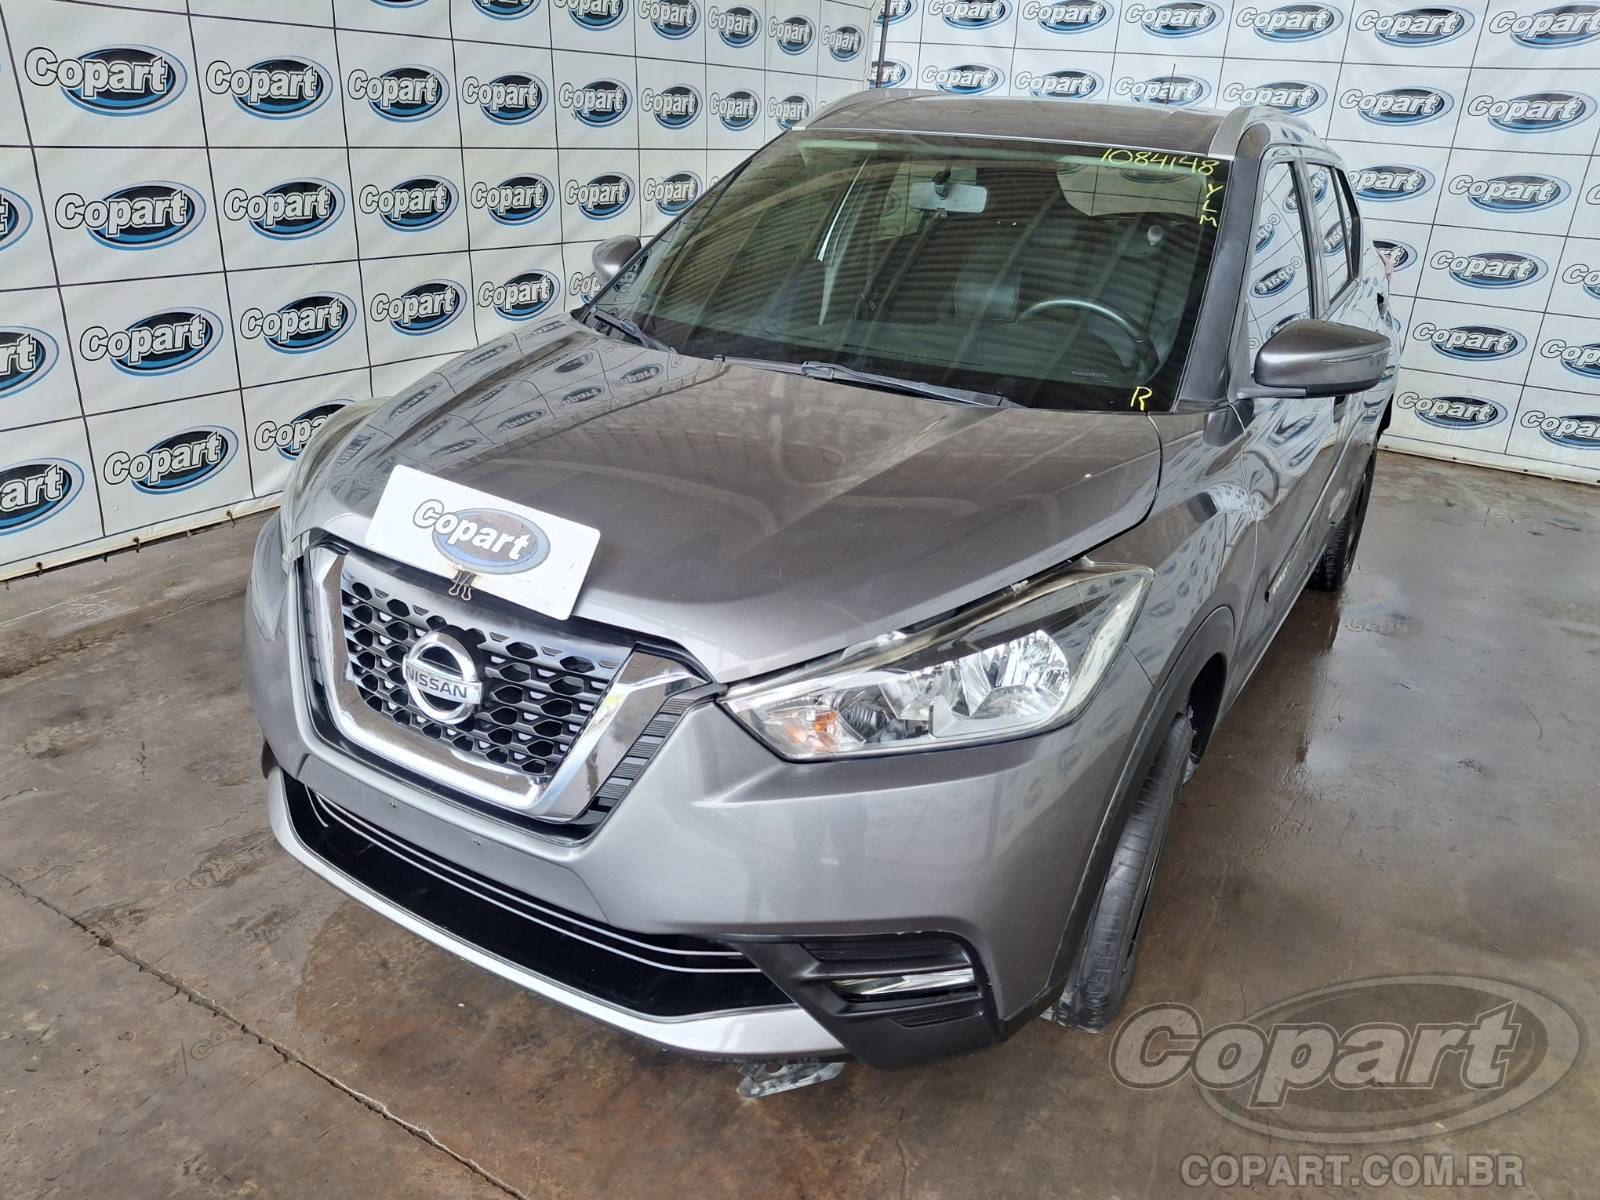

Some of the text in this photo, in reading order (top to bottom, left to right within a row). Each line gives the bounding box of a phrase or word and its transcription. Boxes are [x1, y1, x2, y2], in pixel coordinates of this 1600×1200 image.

[554, 0, 620, 18] opart
[638, 0, 693, 28] Copart
[708, 6, 755, 36] Copart
[927, 0, 1004, 23] Copart
[1022, 1, 1103, 25] Copart
[1125, 3, 1214, 30] Copart
[1236, 7, 1330, 34] Copart
[768, 16, 810, 43] Copart
[821, 25, 862, 51] Copart
[1355, 10, 1460, 38] Copart
[24, 47, 169, 98] Copart
[206, 60, 319, 105] Copart
[921, 65, 994, 93] Copart
[1015, 71, 1092, 96] Copart
[348, 69, 438, 109] Copart
[462, 76, 538, 113] Copart
[559, 82, 626, 115] Copart
[641, 87, 696, 117] Copart
[1115, 76, 1199, 104] Copart
[1223, 82, 1317, 106] Copart
[1339, 88, 1442, 116] Copart
[709, 92, 755, 121] Copart
[768, 96, 810, 124] Copart
[1467, 95, 1584, 125] Copart
[1100, 148, 1220, 176] 1084148
[564, 178, 628, 209] Copart
[643, 177, 699, 208] Copart
[1348, 171, 1421, 192] opart
[1449, 174, 1556, 202] Copart
[224, 186, 332, 228] Copart
[359, 181, 448, 220] Copart
[470, 180, 545, 215] Copart
[55, 190, 188, 237] Copart
[1430, 250, 1536, 279] Copart
[477, 276, 551, 310] Copart
[569, 271, 600, 299] Cop
[370, 285, 455, 325] Copart
[240, 298, 344, 343] Copart
[80, 313, 206, 363] Copart
[1413, 322, 1514, 351] Copart
[1541, 339, 1600, 368] Cop
[1130, 386, 1152, 411] R
[1397, 391, 1495, 422] Copart
[254, 415, 328, 454] Cop
[1520, 410, 1600, 438] Copa
[104, 431, 222, 486] Copart
[0, 464, 63, 512] art
[413, 499, 530, 560] Copart
[405, 665, 468, 699] NISSAN
